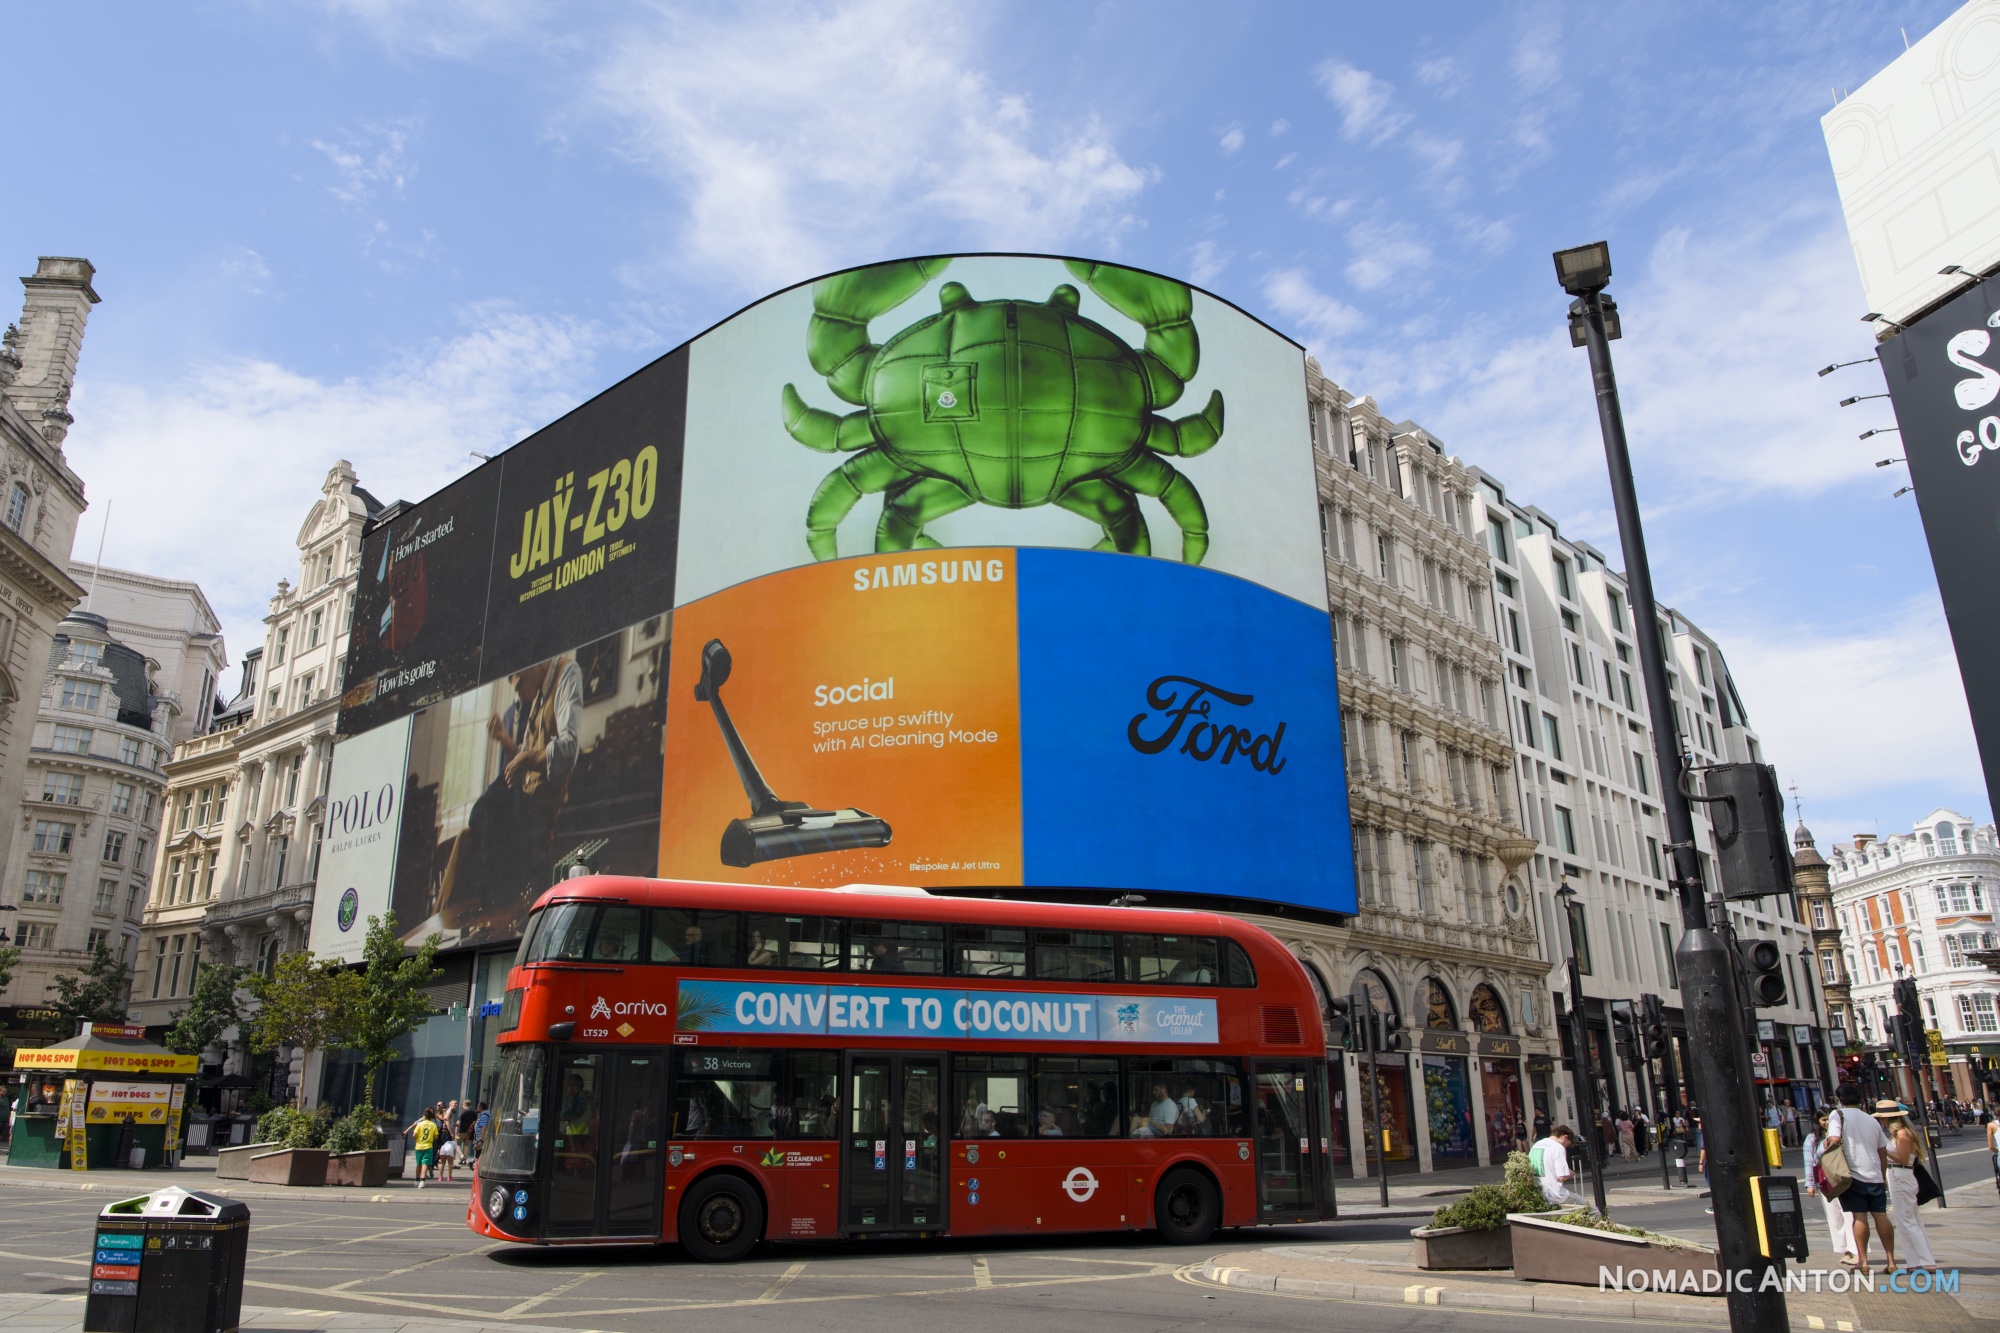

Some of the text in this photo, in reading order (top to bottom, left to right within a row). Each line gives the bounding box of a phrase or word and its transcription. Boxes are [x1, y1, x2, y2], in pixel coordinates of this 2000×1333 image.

[394, 515, 455, 563] How it started.
[609, 538, 625, 553] FRIDAY
[608, 545, 632, 562] SEPTEMBER
[554, 545, 606, 591] LONDON
[853, 559, 1004, 592] SAMSUNG
[378, 677, 399, 697] How
[398, 668, 409, 687] it's
[813, 676, 894, 707] Social
[813, 710, 954, 737] Spruce up swiftly
[1127, 675, 1287, 776] Ford
[813, 729, 998, 753] with AI Cleaning Mode
[327, 782, 394, 840] POLO
[331, 832, 382, 854] RALPH LAUREN
[909, 861, 1000, 873] Bespoke AI Jet Ultra
[614, 999, 667, 1016] arriva
[734, 991, 1092, 1034] CONVERT TO COCONUT
[1173, 1005, 1187, 1014] THE
[1156, 1010, 1205, 1027] Coconut
[92, 1026, 138, 1036] BUY TICKETS HERE
[583, 1029, 608, 1037] LT529
[18, 1053, 35, 1063] HOT
[36, 1054, 54, 1063] DOG
[54, 1054, 75, 1063] SPOT
[103, 1056, 126, 1066] HOT
[127, 1057, 150, 1067] DOG
[150, 1058, 176, 1068] SPOT
[703, 1057, 751, 1070] 38 Victoria
[129, 1091, 151, 1099] DOGS
[422, 1128, 430, 1141] 9
